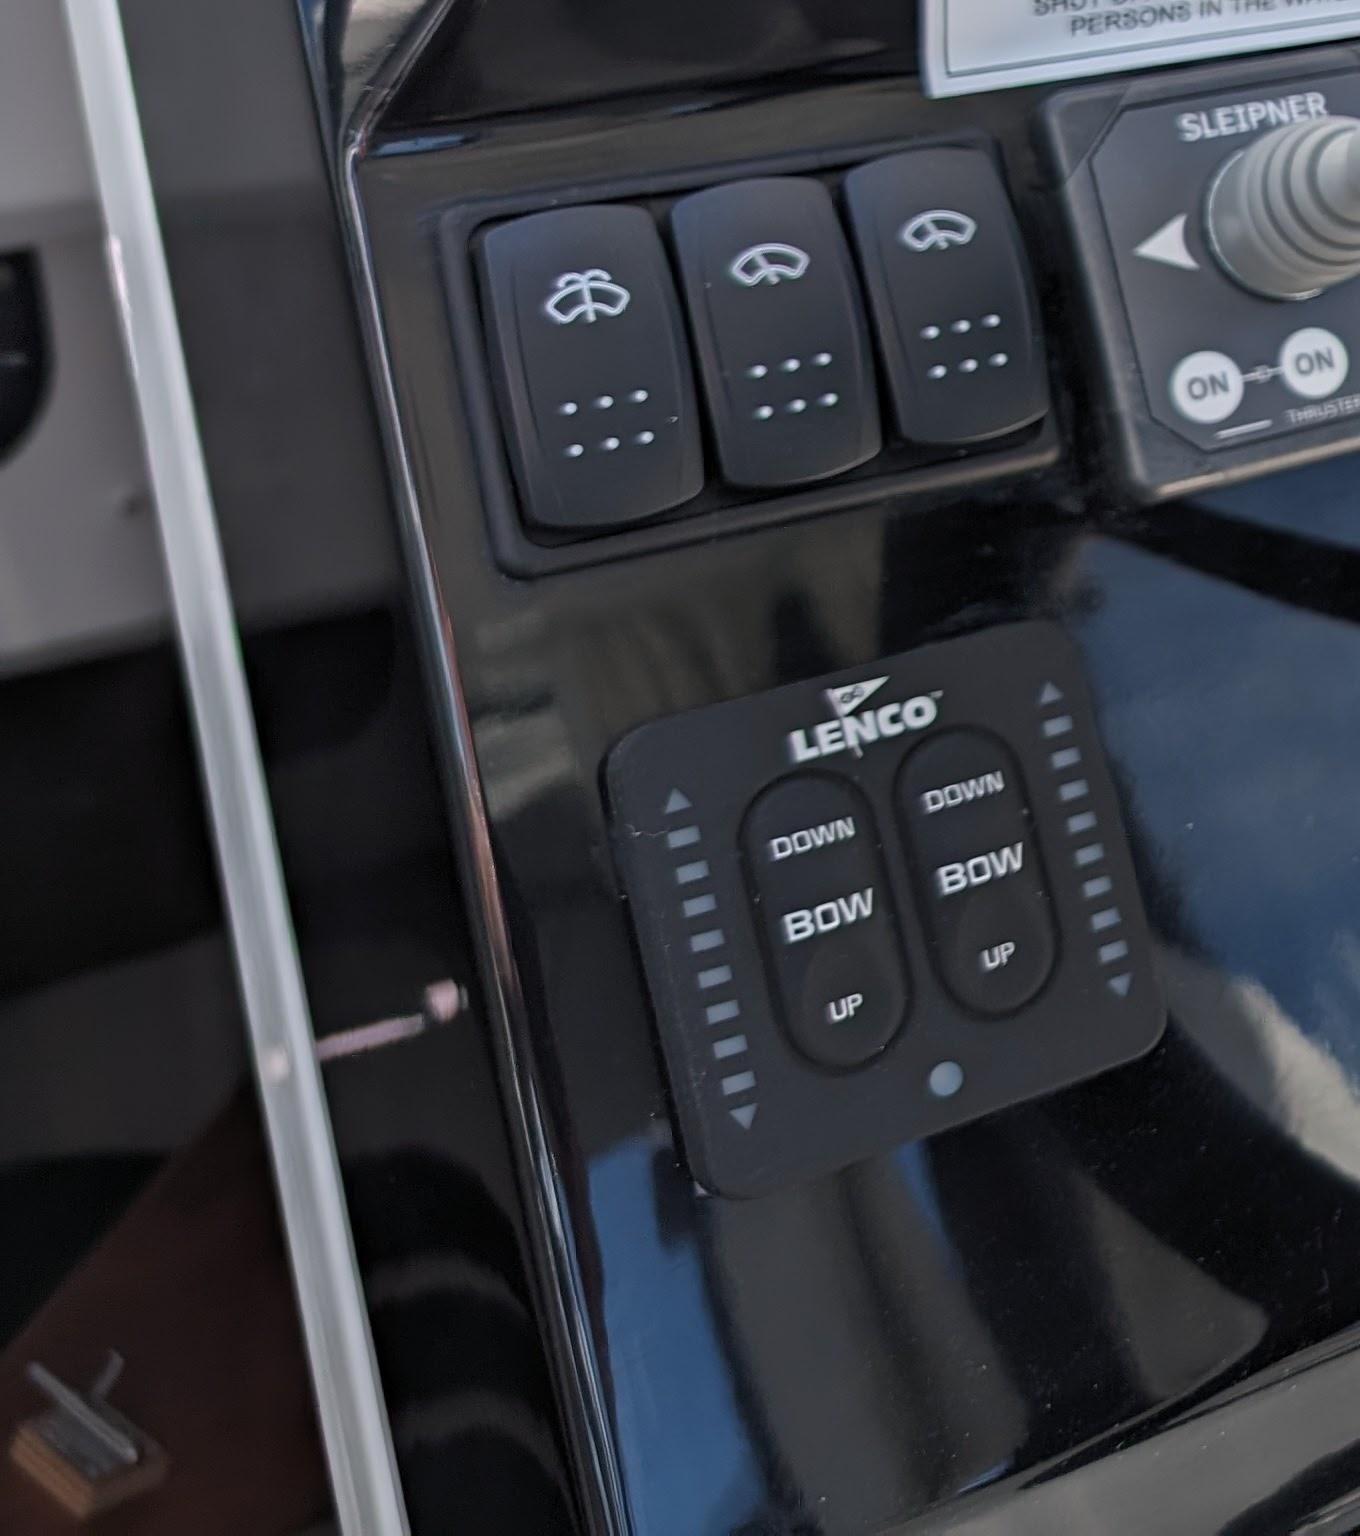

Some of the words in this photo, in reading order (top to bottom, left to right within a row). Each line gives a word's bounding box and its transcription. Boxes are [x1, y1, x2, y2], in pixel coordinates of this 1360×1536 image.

[1070, 0, 1192, 38] PERSONS
[1178, 91, 1328, 142] SLEIPNER
[1295, 347, 1335, 377] ON
[1187, 372, 1230, 401] ON
[788, 695, 938, 763] LENCO
[922, 770, 1006, 814] DOWN
[769, 816, 856, 861] DOWN
[936, 842, 1025, 897] BOW
[783, 887, 875, 944] BOW
[980, 940, 1016, 971] UP
[827, 992, 863, 1024] UP
